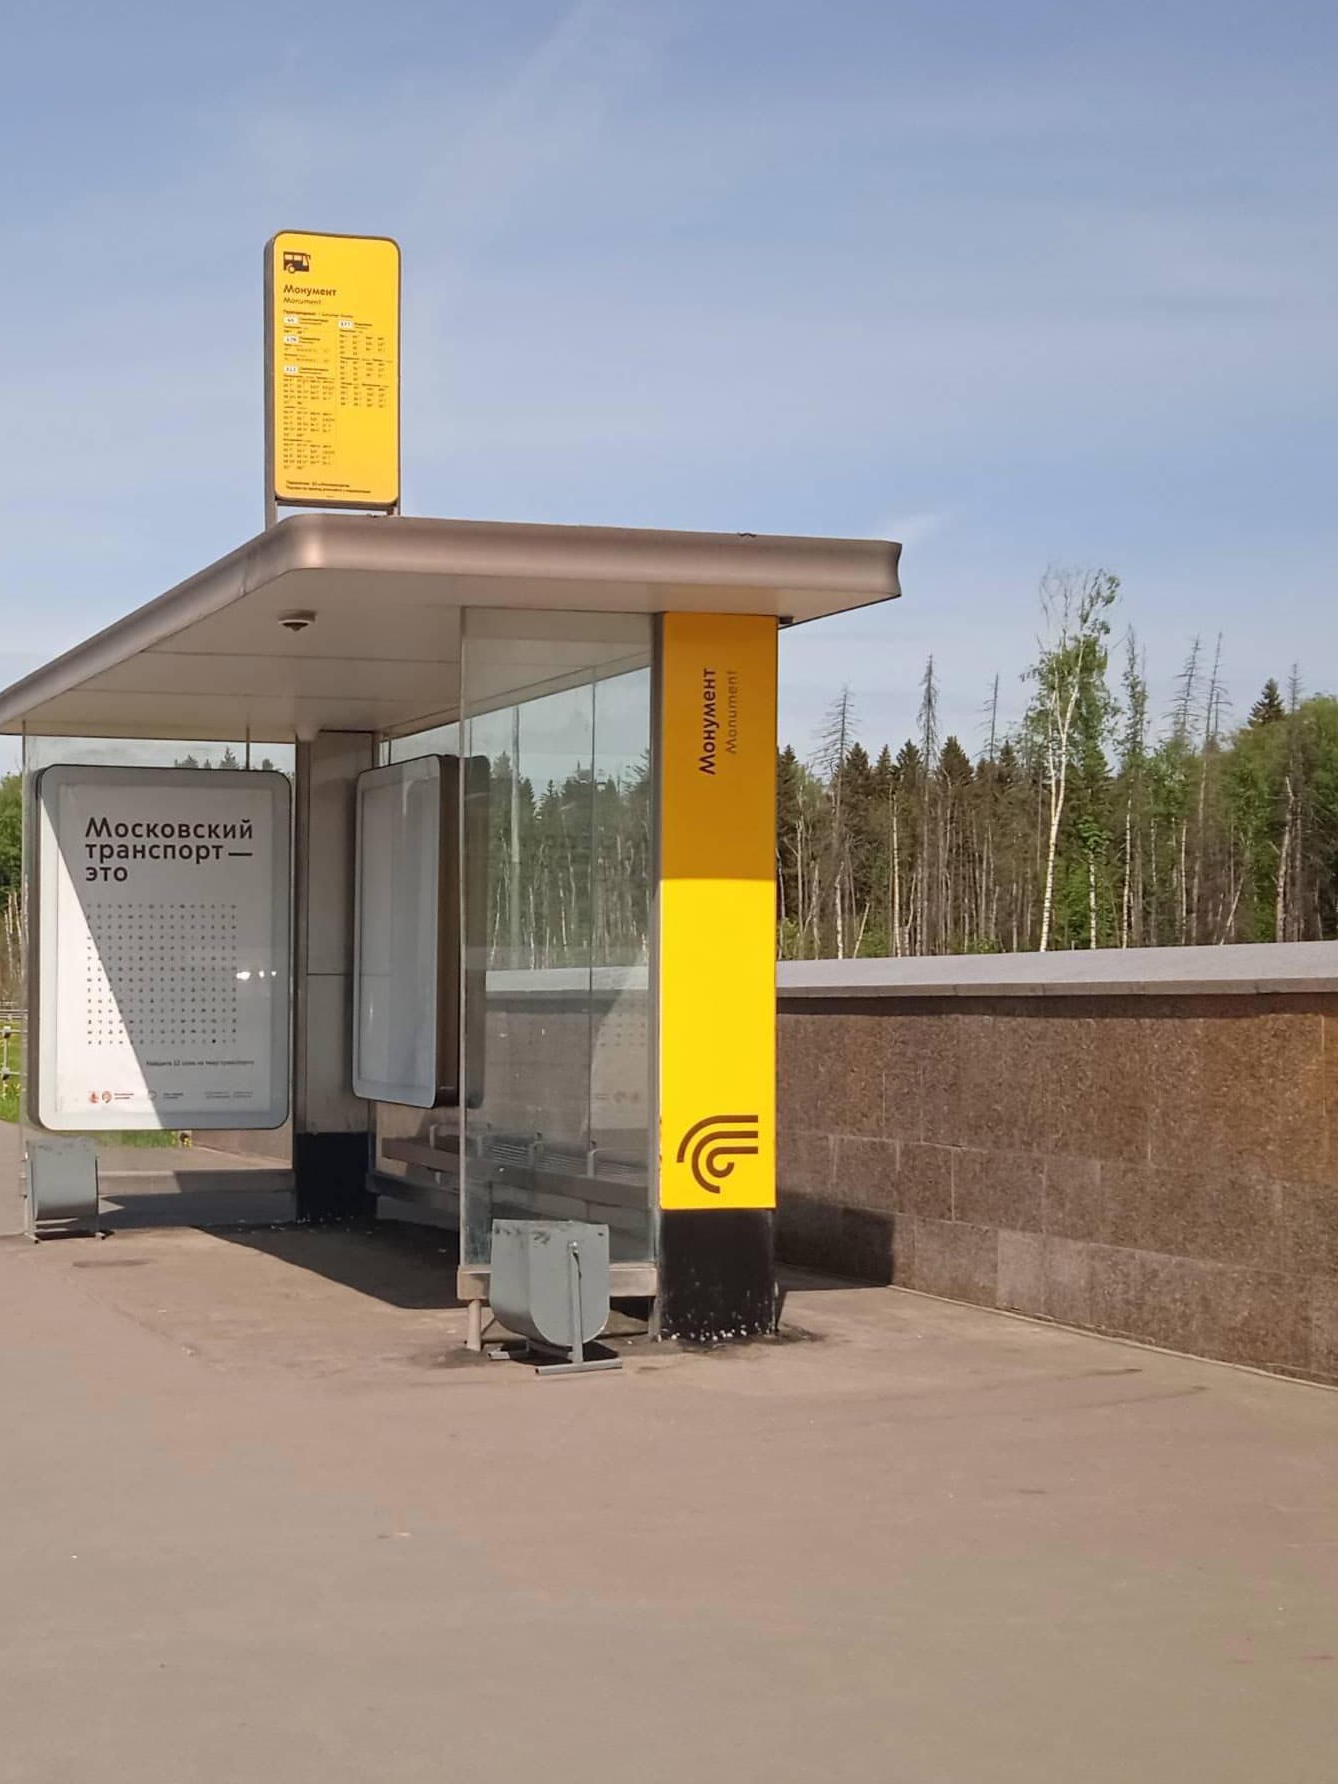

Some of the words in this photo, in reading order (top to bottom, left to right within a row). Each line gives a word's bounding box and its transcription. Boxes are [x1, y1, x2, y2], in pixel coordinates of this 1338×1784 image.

[283, 284, 337, 297] Монумент
[698, 668, 720, 775] Монумент
[726, 670, 737, 754] Monument
[85, 817, 253, 840] Московский
[85, 867, 128, 882] это
